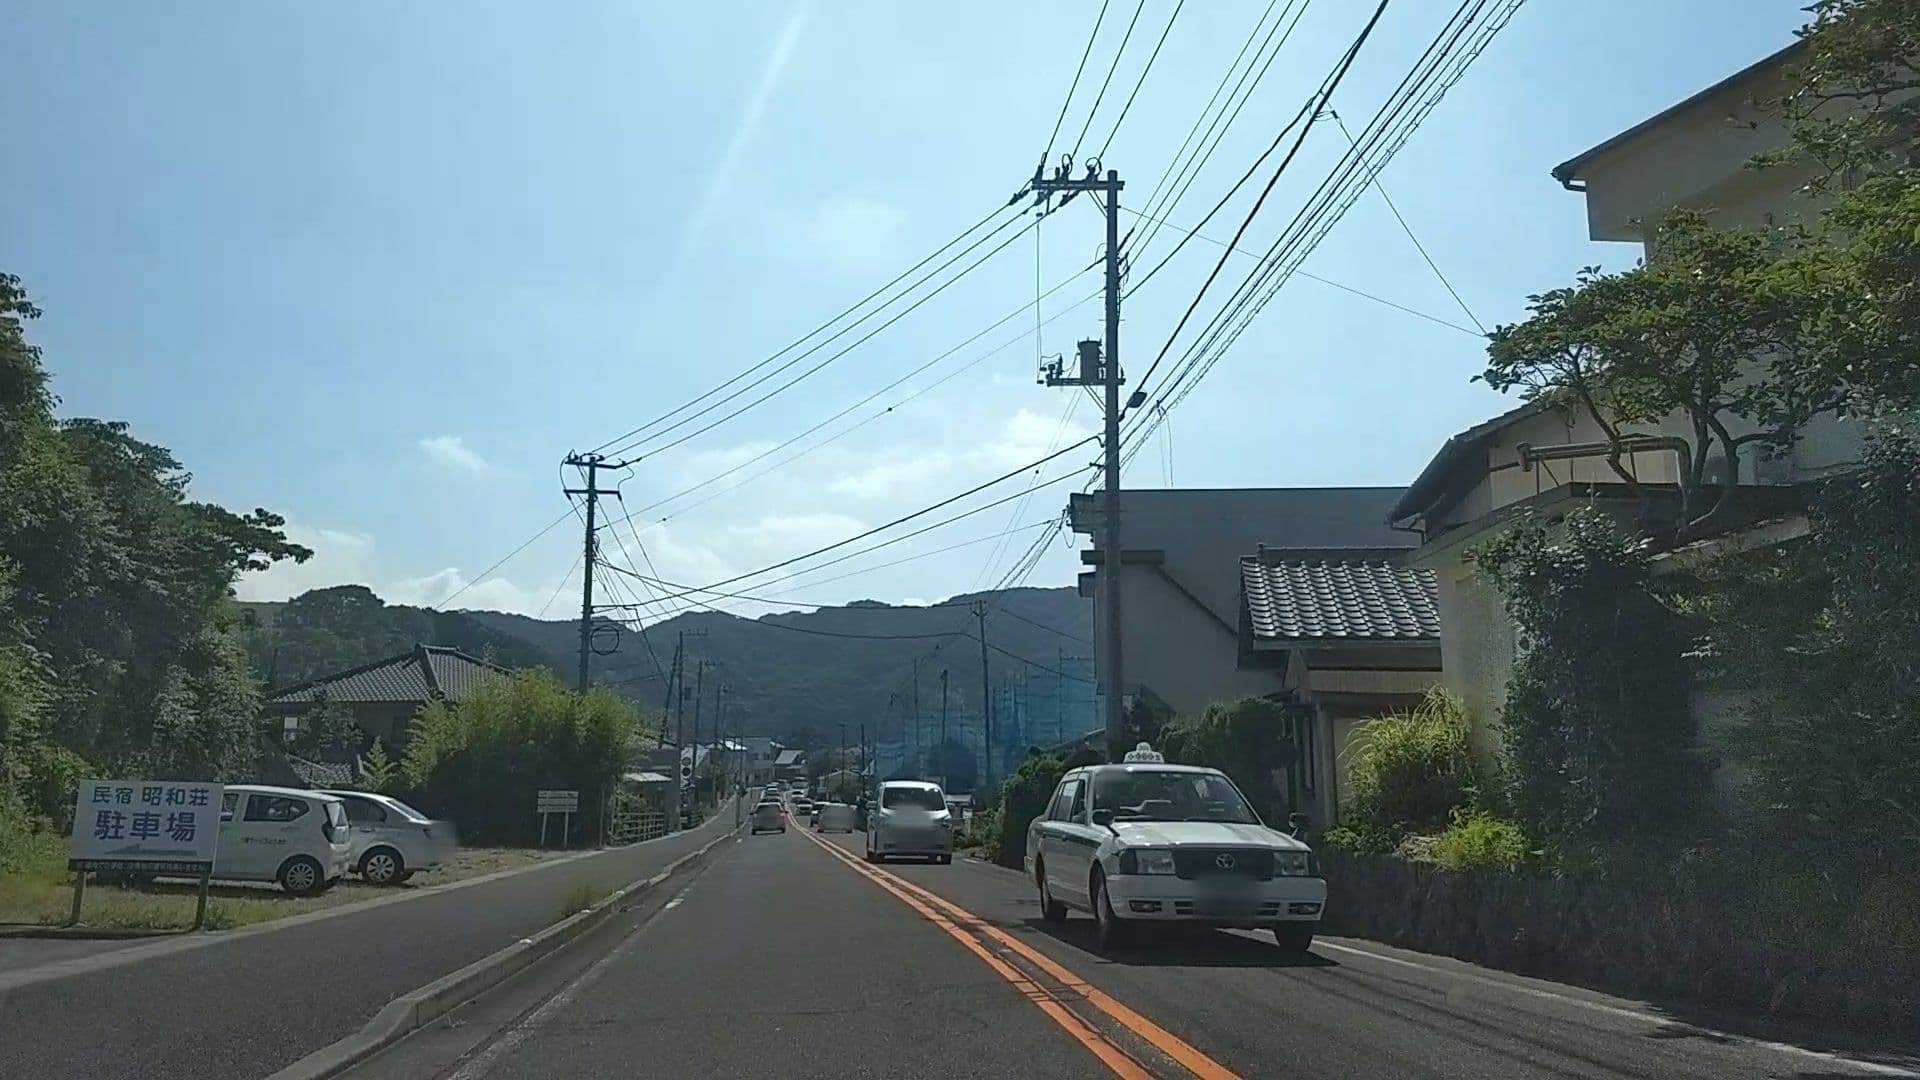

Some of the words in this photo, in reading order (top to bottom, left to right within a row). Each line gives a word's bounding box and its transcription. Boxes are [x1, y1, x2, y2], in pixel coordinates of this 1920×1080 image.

[92, 786, 134, 804] 民宿
[141, 786, 209, 806] 昭和荘
[94, 810, 197, 842] 駐車場
